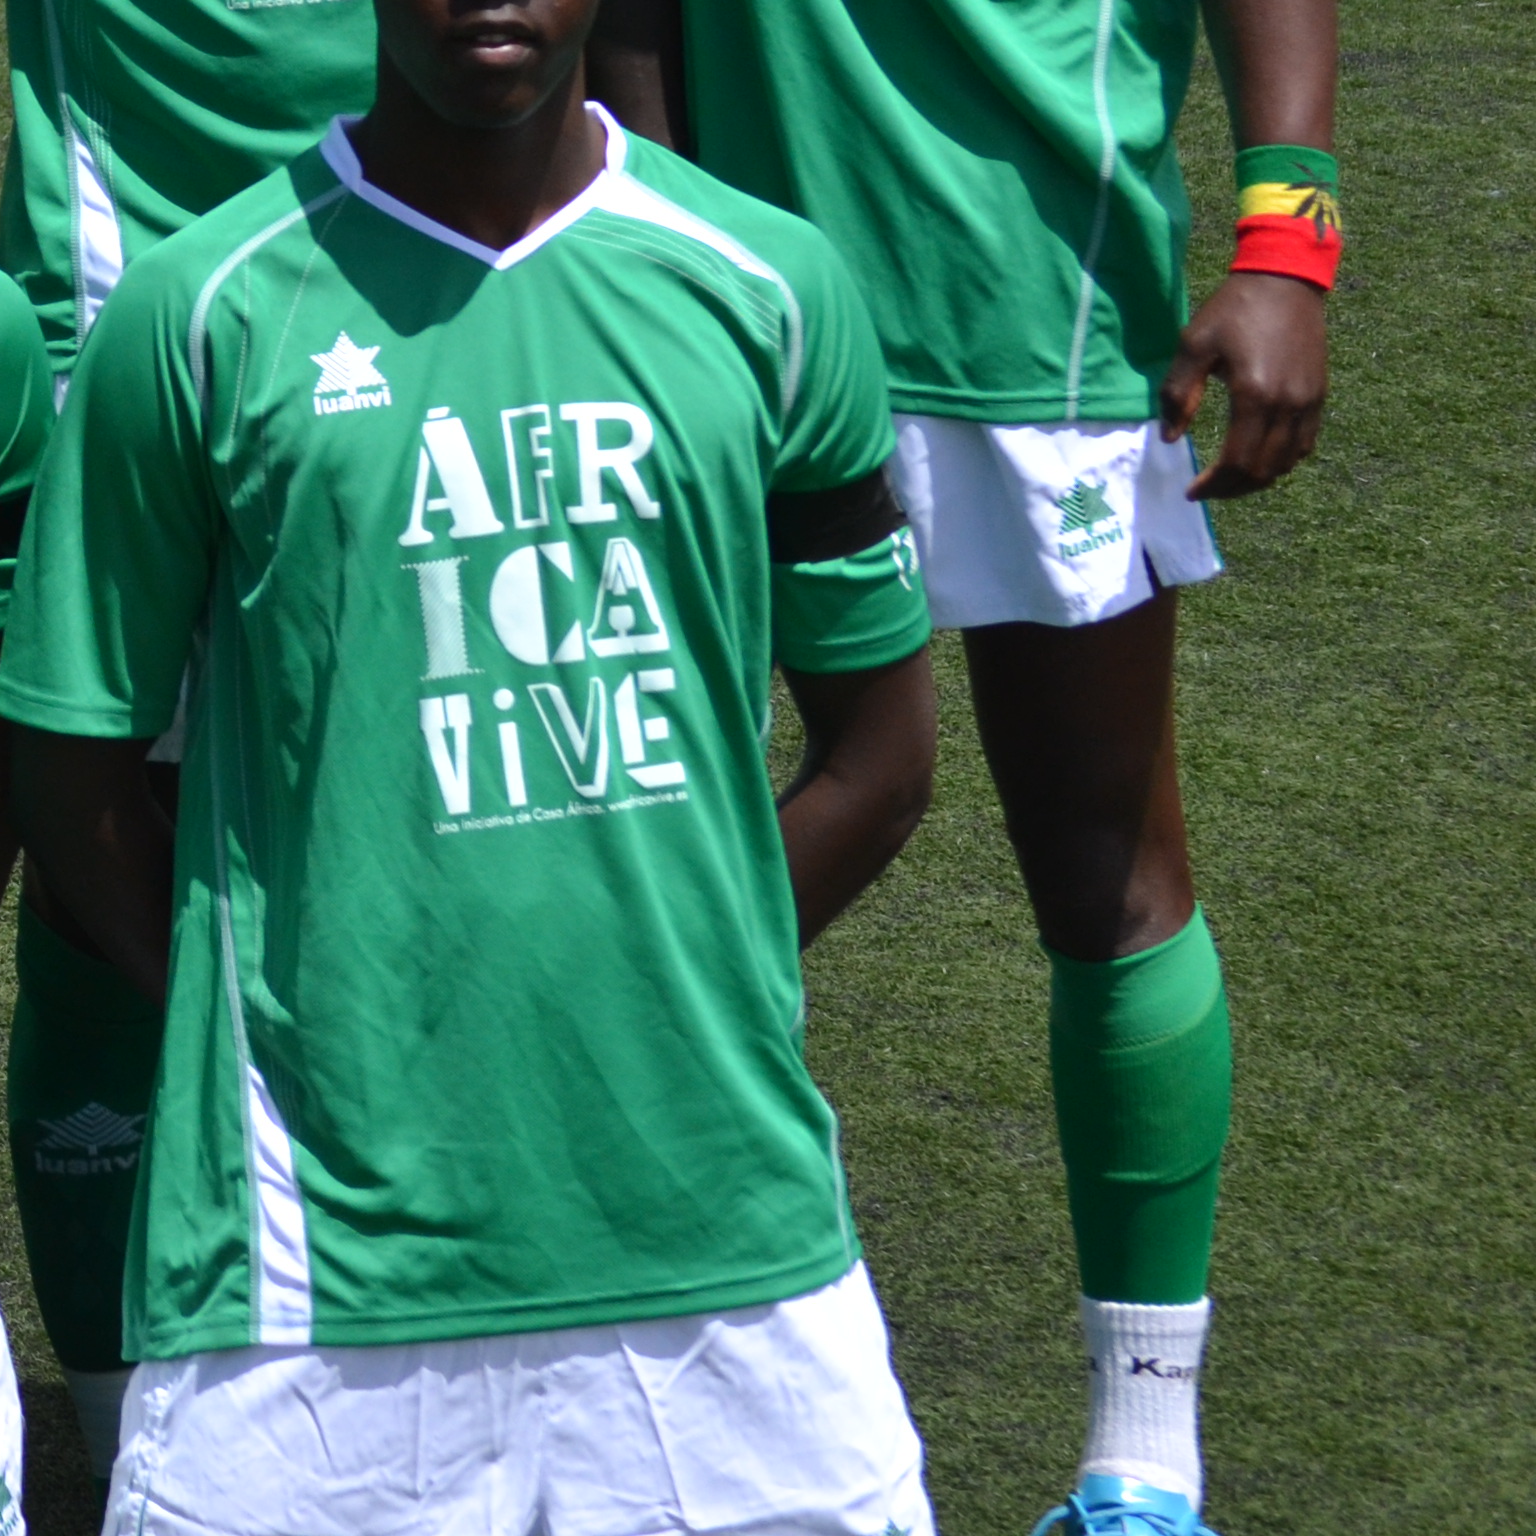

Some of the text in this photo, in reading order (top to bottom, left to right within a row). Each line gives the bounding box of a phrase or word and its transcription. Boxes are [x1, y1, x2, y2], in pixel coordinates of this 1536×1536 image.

[313, 386, 392, 415] luanvi
[398, 401, 661, 546] ÁFR
[1058, 521, 1125, 561] luanvi
[401, 537, 670, 681] ICA
[419, 667, 686, 815] ViVE
[433, 822, 460, 835] Una
[532, 807, 565, 821] Casa
